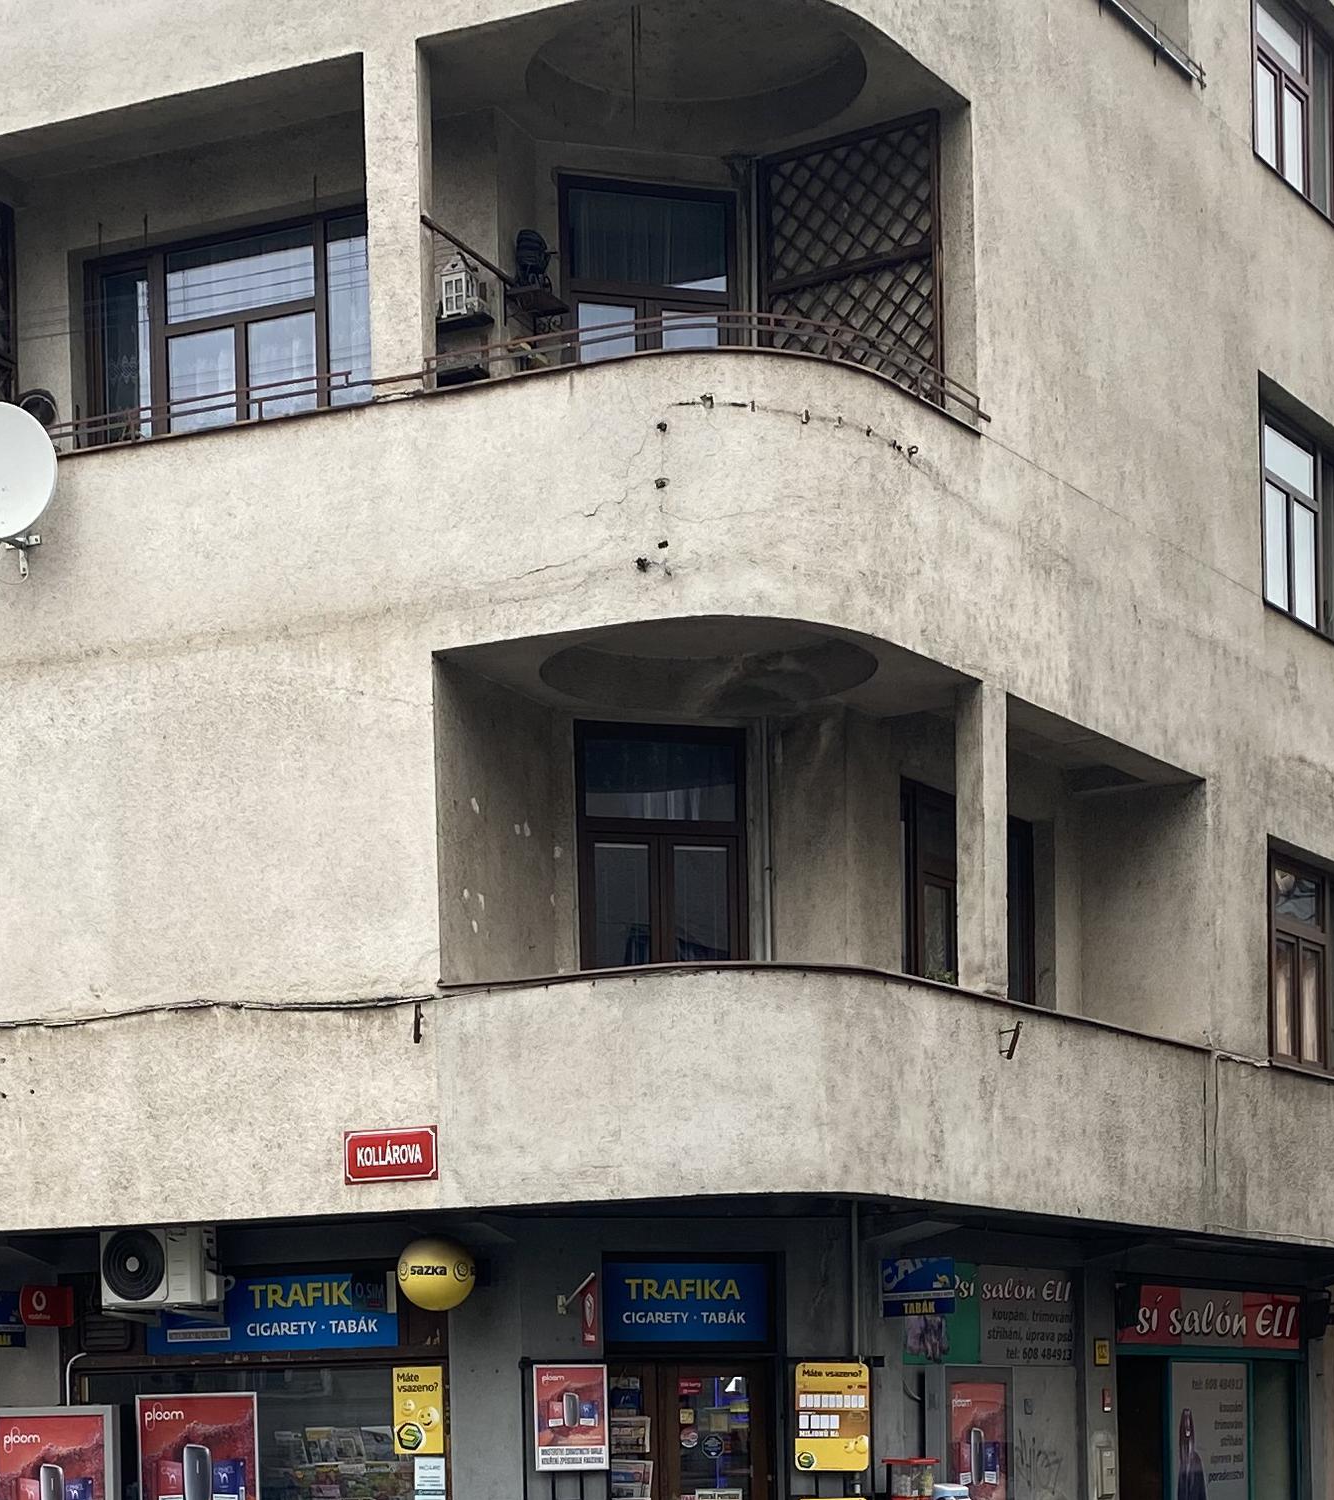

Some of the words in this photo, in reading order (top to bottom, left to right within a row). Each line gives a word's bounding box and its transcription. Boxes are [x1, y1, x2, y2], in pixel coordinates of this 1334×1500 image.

[356, 1139, 423, 1168] KOLLÁROVA
[410, 1264, 447, 1276] sazka
[247, 1281, 352, 1309] TRAFIK
[624, 1278, 742, 1301] TRAFIKA
[622, 1311, 689, 1324] CIGARETY
[701, 1309, 746, 1324] TABÁK
[903, 1300, 936, 1314] TABÁK
[1136, 1295, 1163, 1335] sí
[1169, 1299, 1247, 1337] salón
[1255, 1304, 1296, 1337] ELI
[247, 1320, 317, 1337] CIGARETY
[329, 1316, 378, 1334] TABÁK
[1022, 1347, 1038, 1361] 608
[1041, 1347, 1072, 1361] 484913
[396, 1372, 419, 1383] Máte
[397, 1382, 439, 1393] vsazeno?
[145, 1402, 185, 1431] ploom
[3, 1426, 41, 1454] ploom
